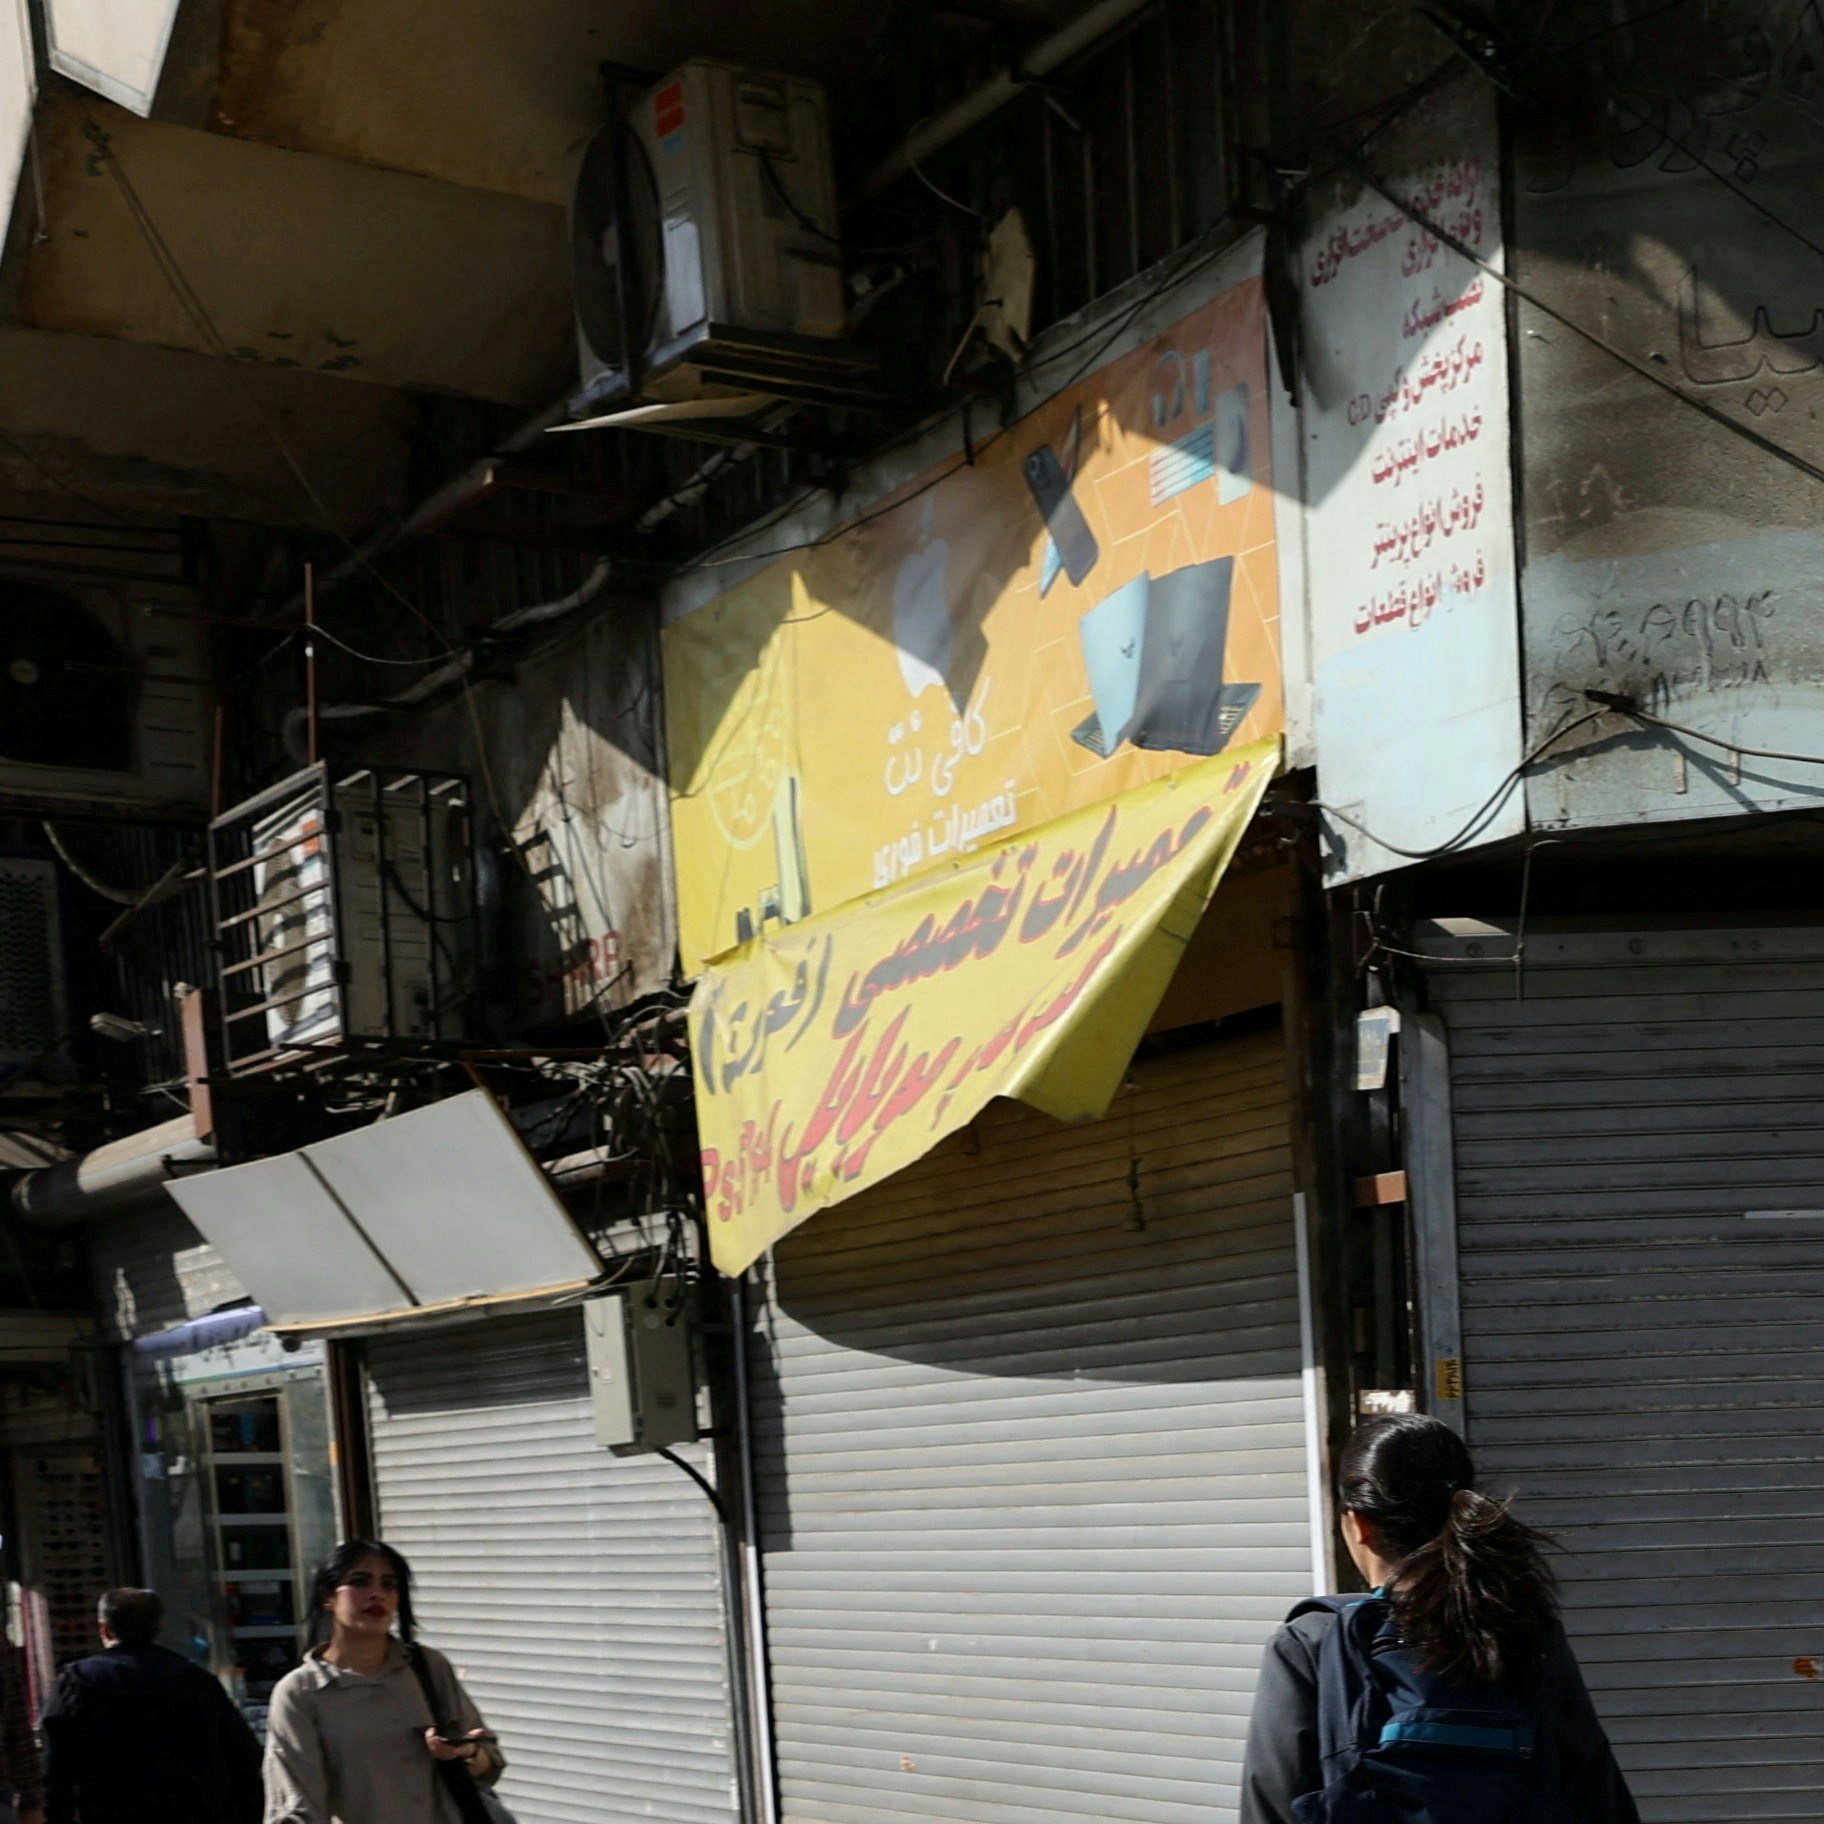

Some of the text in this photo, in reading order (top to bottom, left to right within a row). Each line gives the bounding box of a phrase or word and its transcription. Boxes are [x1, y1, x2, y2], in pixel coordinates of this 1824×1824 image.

[1347, 393, 1371, 427] CD
[883, 710, 924, 796] نت
[927, 777, 1019, 858] تعمیرات
[832, 841, 1042, 1041] تخصصی
